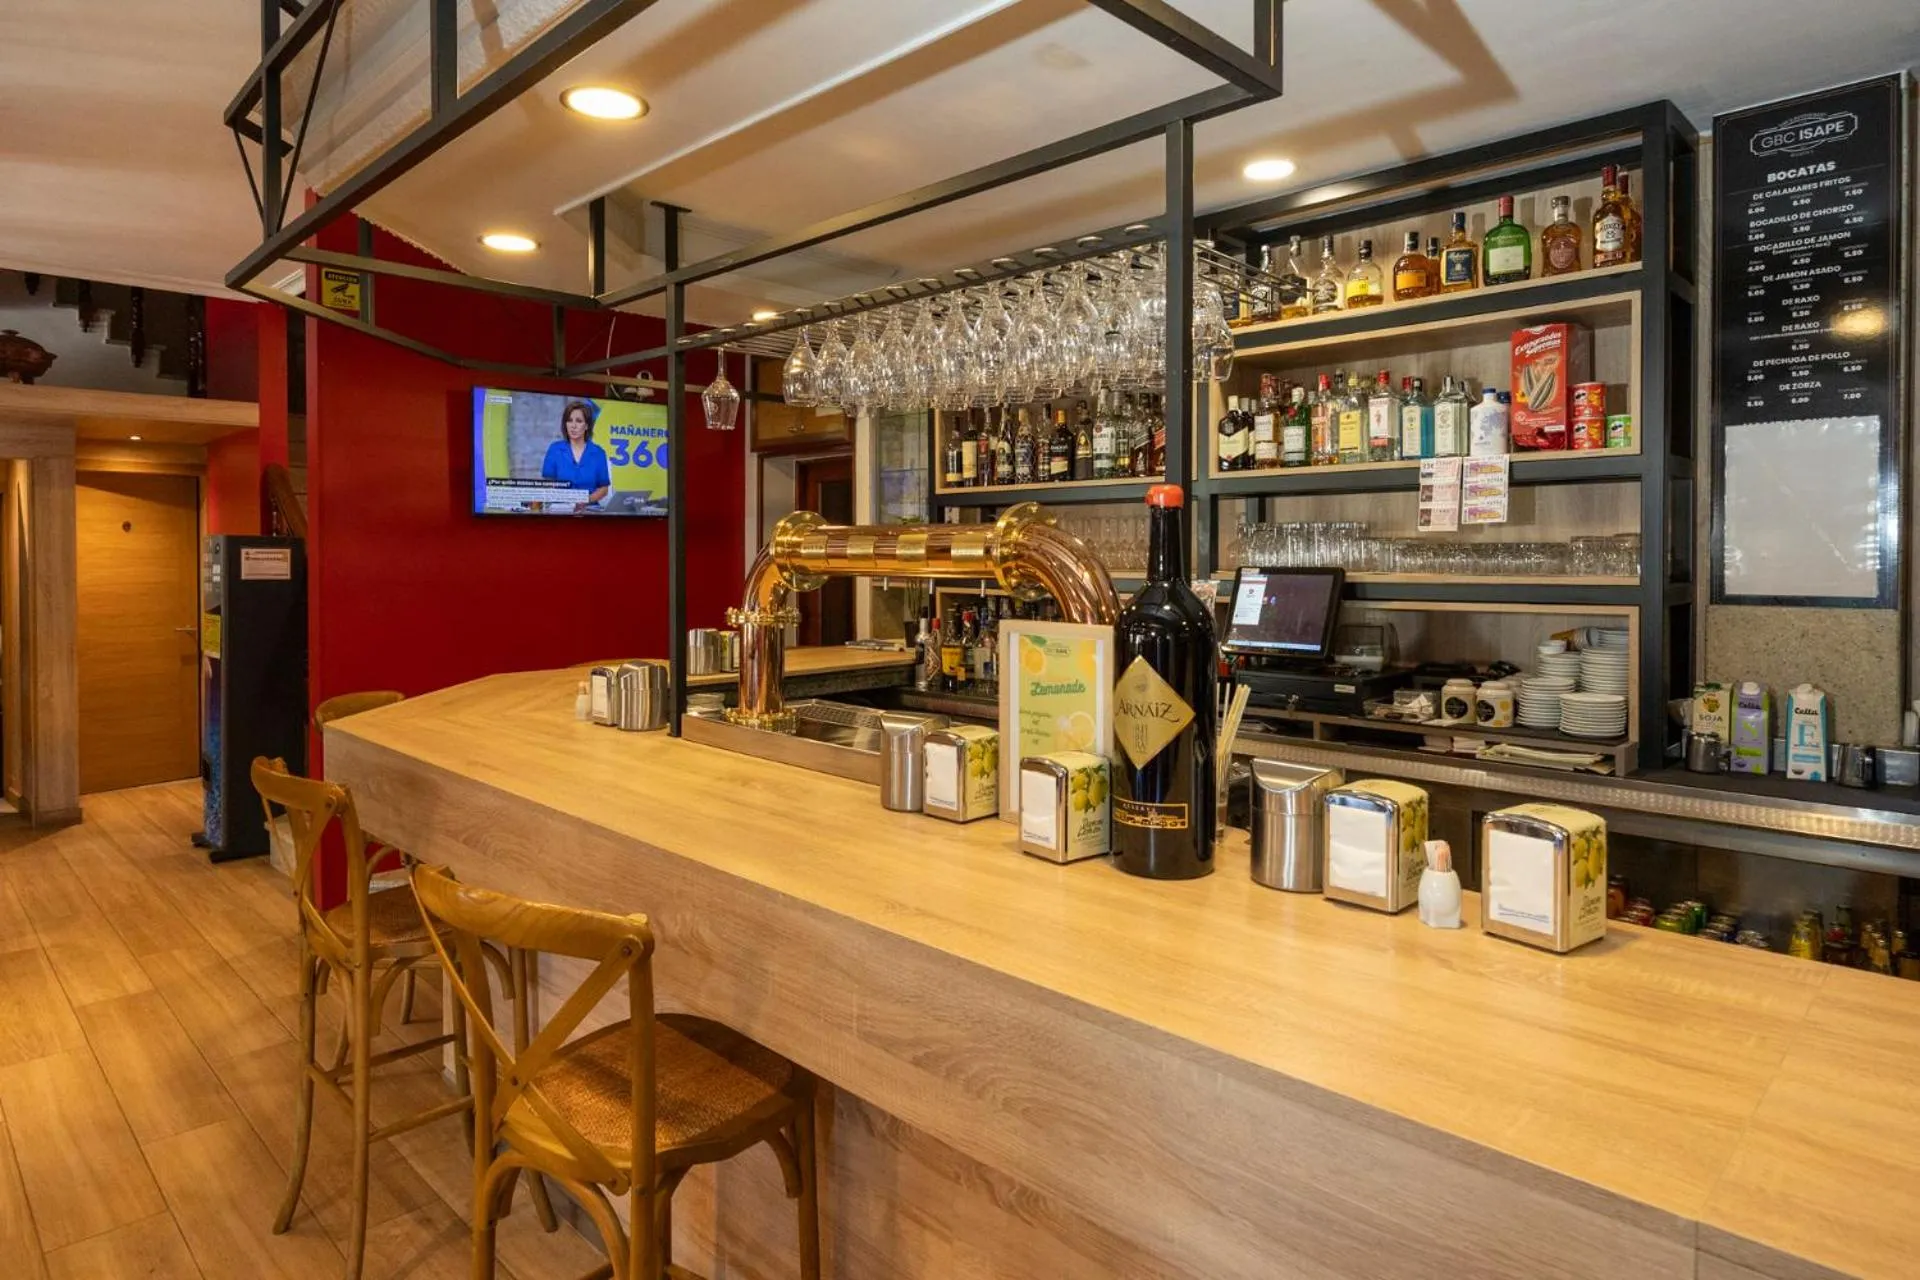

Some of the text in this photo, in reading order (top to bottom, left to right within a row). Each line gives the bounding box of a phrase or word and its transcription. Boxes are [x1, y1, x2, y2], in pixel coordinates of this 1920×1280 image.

[1761, 132, 1796, 148] GBC
[1799, 120, 1845, 140] ISAPE
[1767, 161, 1836, 182] BOCATAS
[1752, 192, 1764, 201] DE
[1765, 182, 1819, 199] CALAMARES
[1819, 176, 1852, 188] FRITOS
[1749, 213, 1799, 228] BOCADILLO
[1799, 210, 1812, 219] DE
[1812, 203, 1855, 217] CHORIZO
[1754, 238, 1803, 253] BOCADILLO
[1804, 235, 1817, 244] DE
[1817, 231, 1852, 243] JAMON
[1762, 275, 1774, 283] DE
[1774, 269, 1808, 281] JAMON
[1809, 265, 1842, 276] ASADO
[1781, 294, 1821, 306] DE RAXO
[1781, 321, 1821, 332] DE RAXO
[1752, 351, 1851, 367] DE PECHUGA DE POLLO
[1779, 383, 1791, 391] DE
[1030, 679, 1087, 697] Lemonade
[1114, 700, 1181, 723] ARNAIZ
[1699, 713, 1723, 723] SOJA
